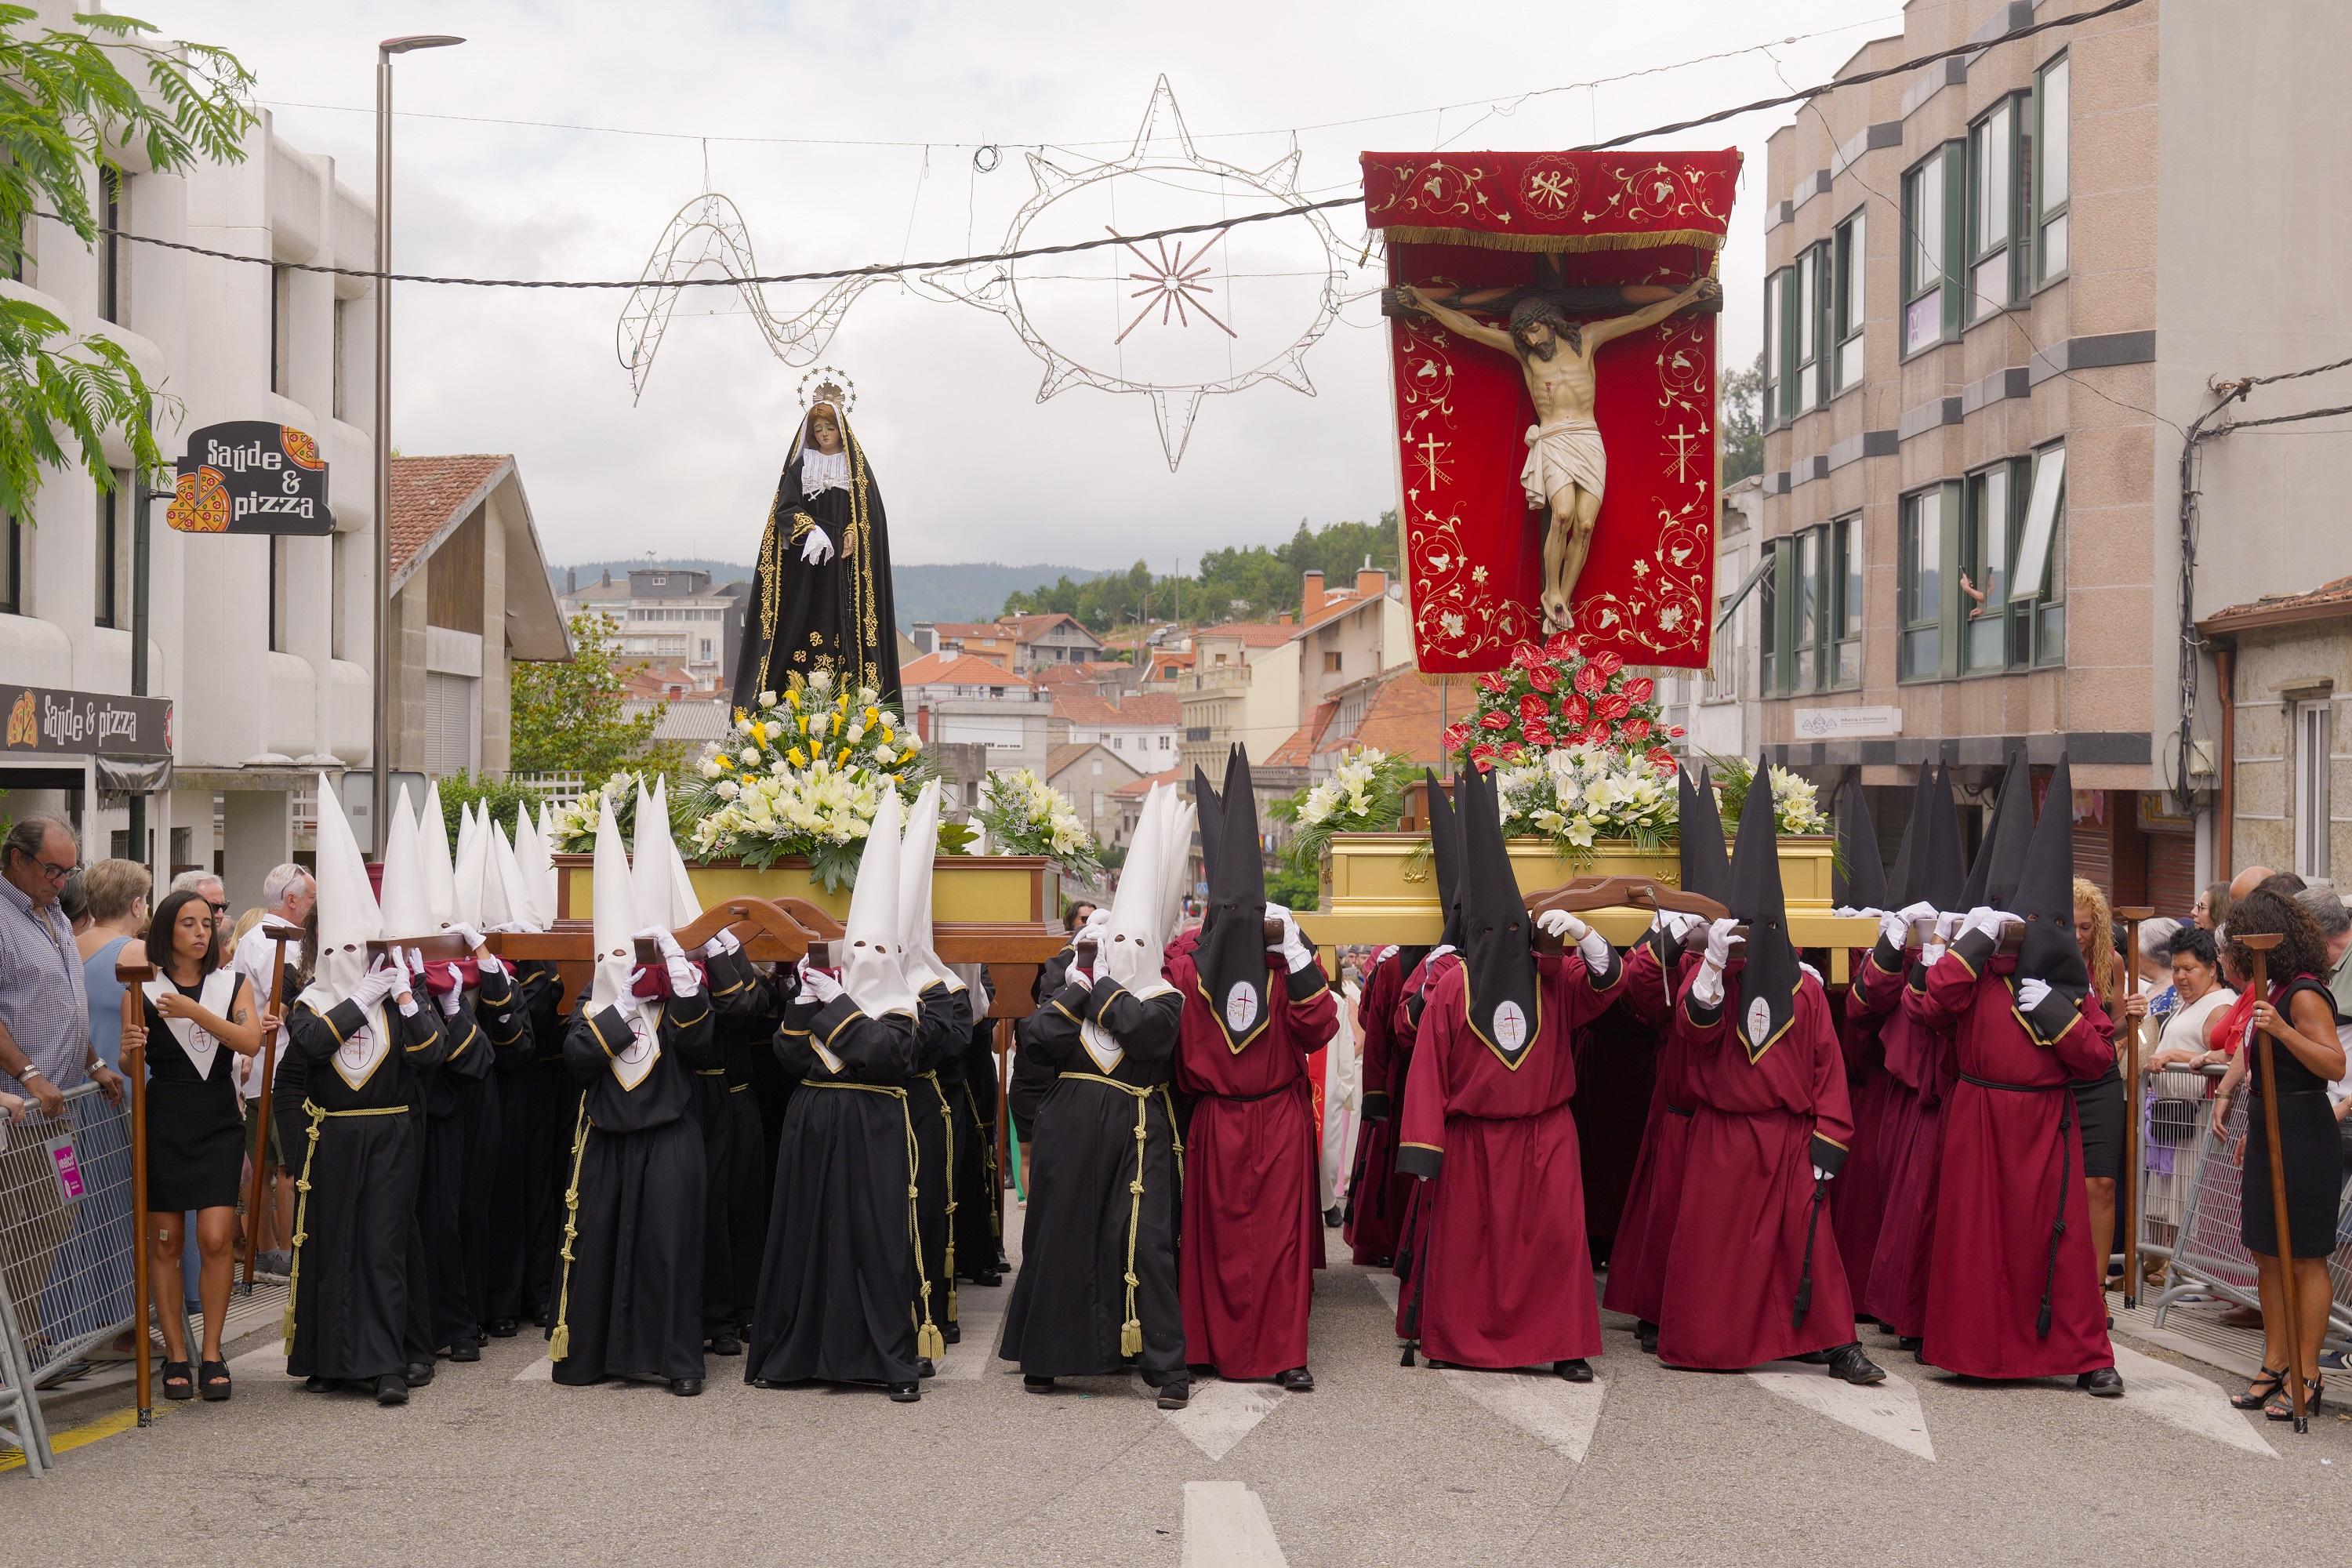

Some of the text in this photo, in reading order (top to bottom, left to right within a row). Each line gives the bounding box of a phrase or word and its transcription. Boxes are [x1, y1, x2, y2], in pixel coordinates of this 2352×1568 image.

[208, 439, 282, 473] Saúde
[282, 470, 302, 495] &
[234, 491, 314, 521] pizza
[44, 695, 83, 746] Saúde
[85, 702, 95, 735] &
[99, 702, 136, 747] pizza
